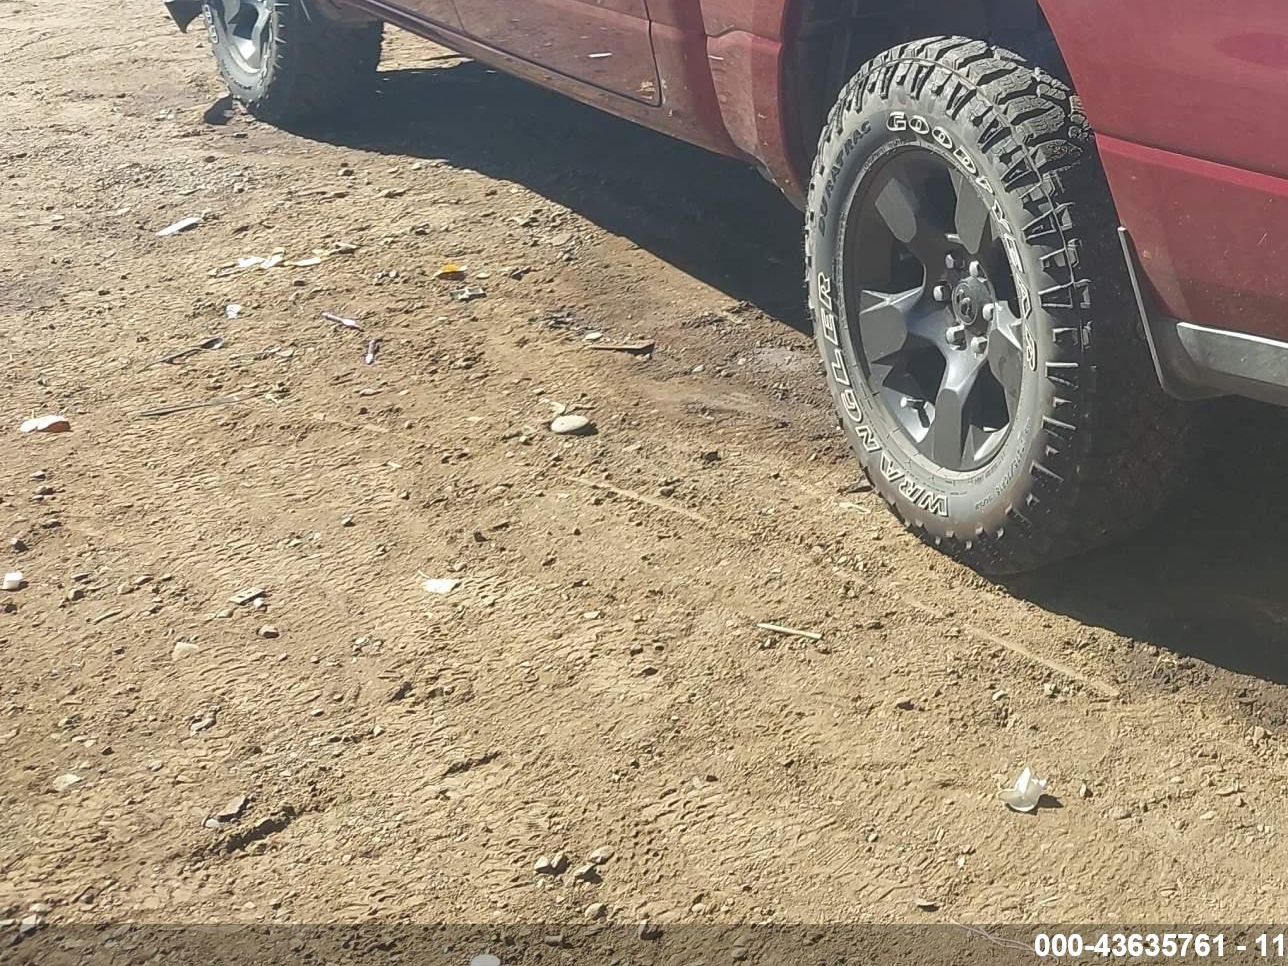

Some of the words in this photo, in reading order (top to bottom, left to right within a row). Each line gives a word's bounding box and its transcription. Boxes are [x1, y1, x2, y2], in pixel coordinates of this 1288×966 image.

[818, 120, 872, 238] DURATRAC
[886, 111, 1037, 372] GOODYEAR
[818, 271, 949, 518] WRANGLER
